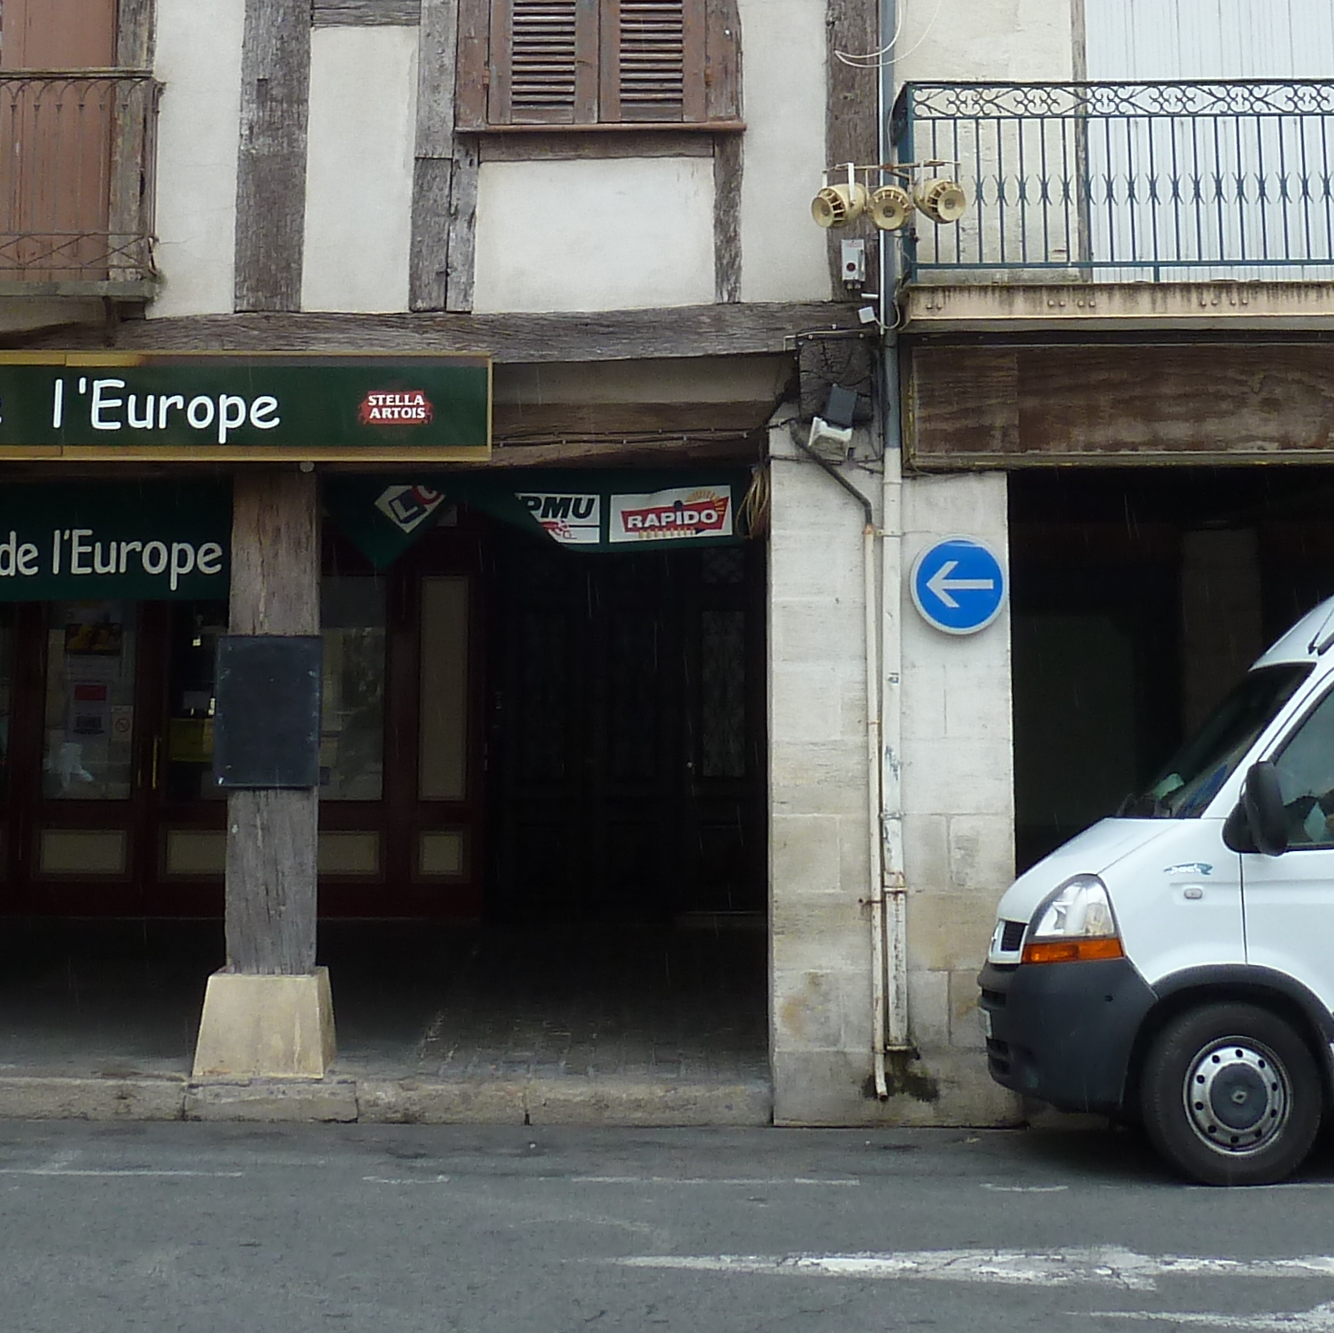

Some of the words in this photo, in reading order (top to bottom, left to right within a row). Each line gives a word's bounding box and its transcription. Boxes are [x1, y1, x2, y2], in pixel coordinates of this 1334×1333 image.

[53, 377, 280, 444] l'Europe
[368, 394, 425, 406] STELLA
[369, 407, 426, 419] ARTOIS
[520, 494, 596, 519] PMU
[627, 509, 718, 528] RAPIDO
[52, 529, 223, 591] l'Europe
